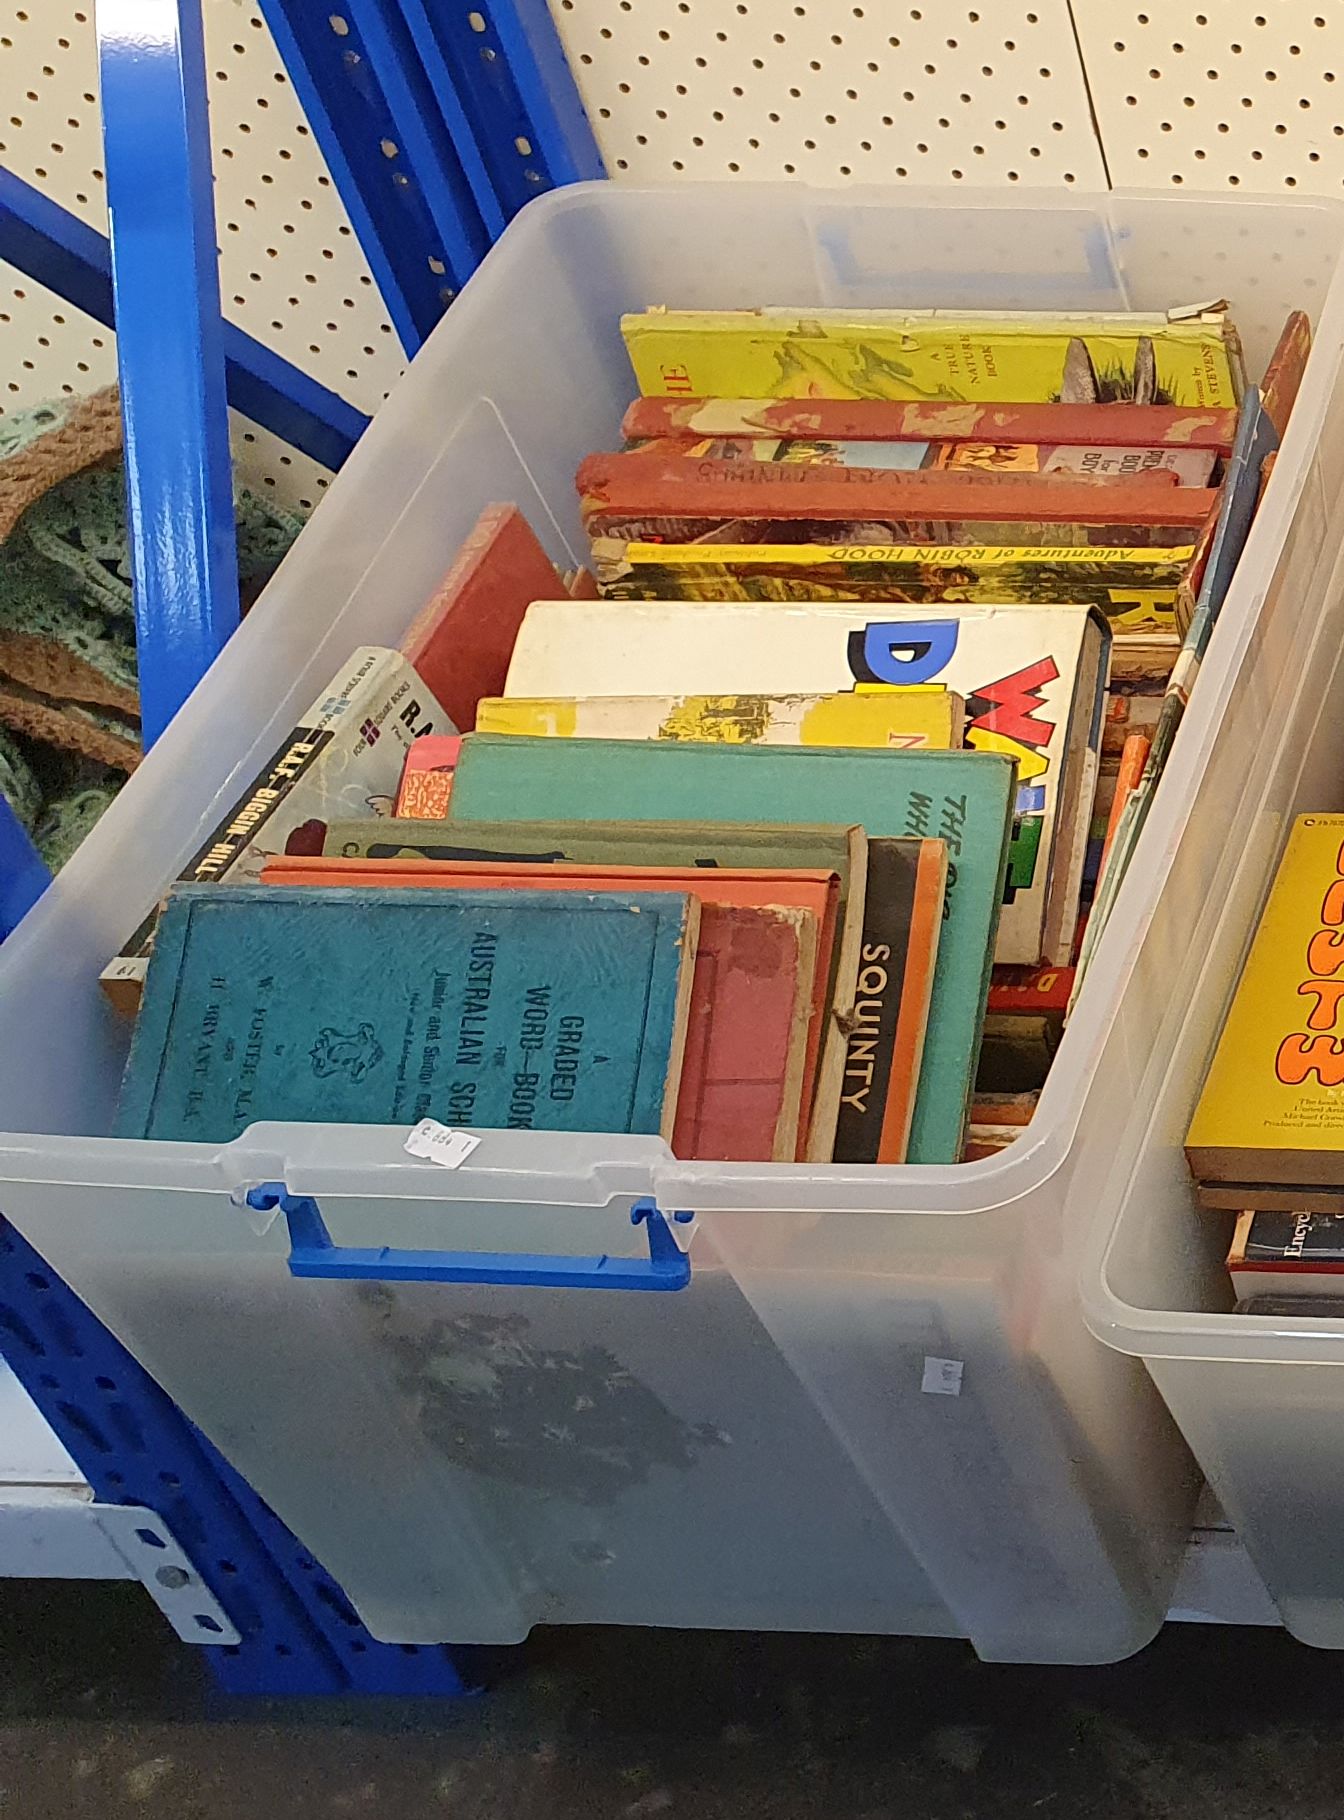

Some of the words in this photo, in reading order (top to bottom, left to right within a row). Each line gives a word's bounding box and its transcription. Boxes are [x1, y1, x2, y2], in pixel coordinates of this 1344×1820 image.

[944, 344, 960, 375] TRUE
[960, 334, 980, 385] NATURE
[983, 345, 998, 377] BOOK
[1201, 342, 1220, 396] STEVENS
[826, 547, 903, 561] HOOD
[913, 548, 984, 562] ROBIN
[991, 549, 1016, 562] of
[1022, 549, 1136, 562] Adventures
[226, 788, 280, 836] BIGGIN
[194, 842, 237, 875] HILL
[432, 967, 452, 1010] Junior
[456, 931, 498, 1066] AUSTRALIAN
[426, 1015, 441, 1042] and
[841, 943, 891, 1114] SQUINTY
[550, 1015, 585, 1102] GRADED
